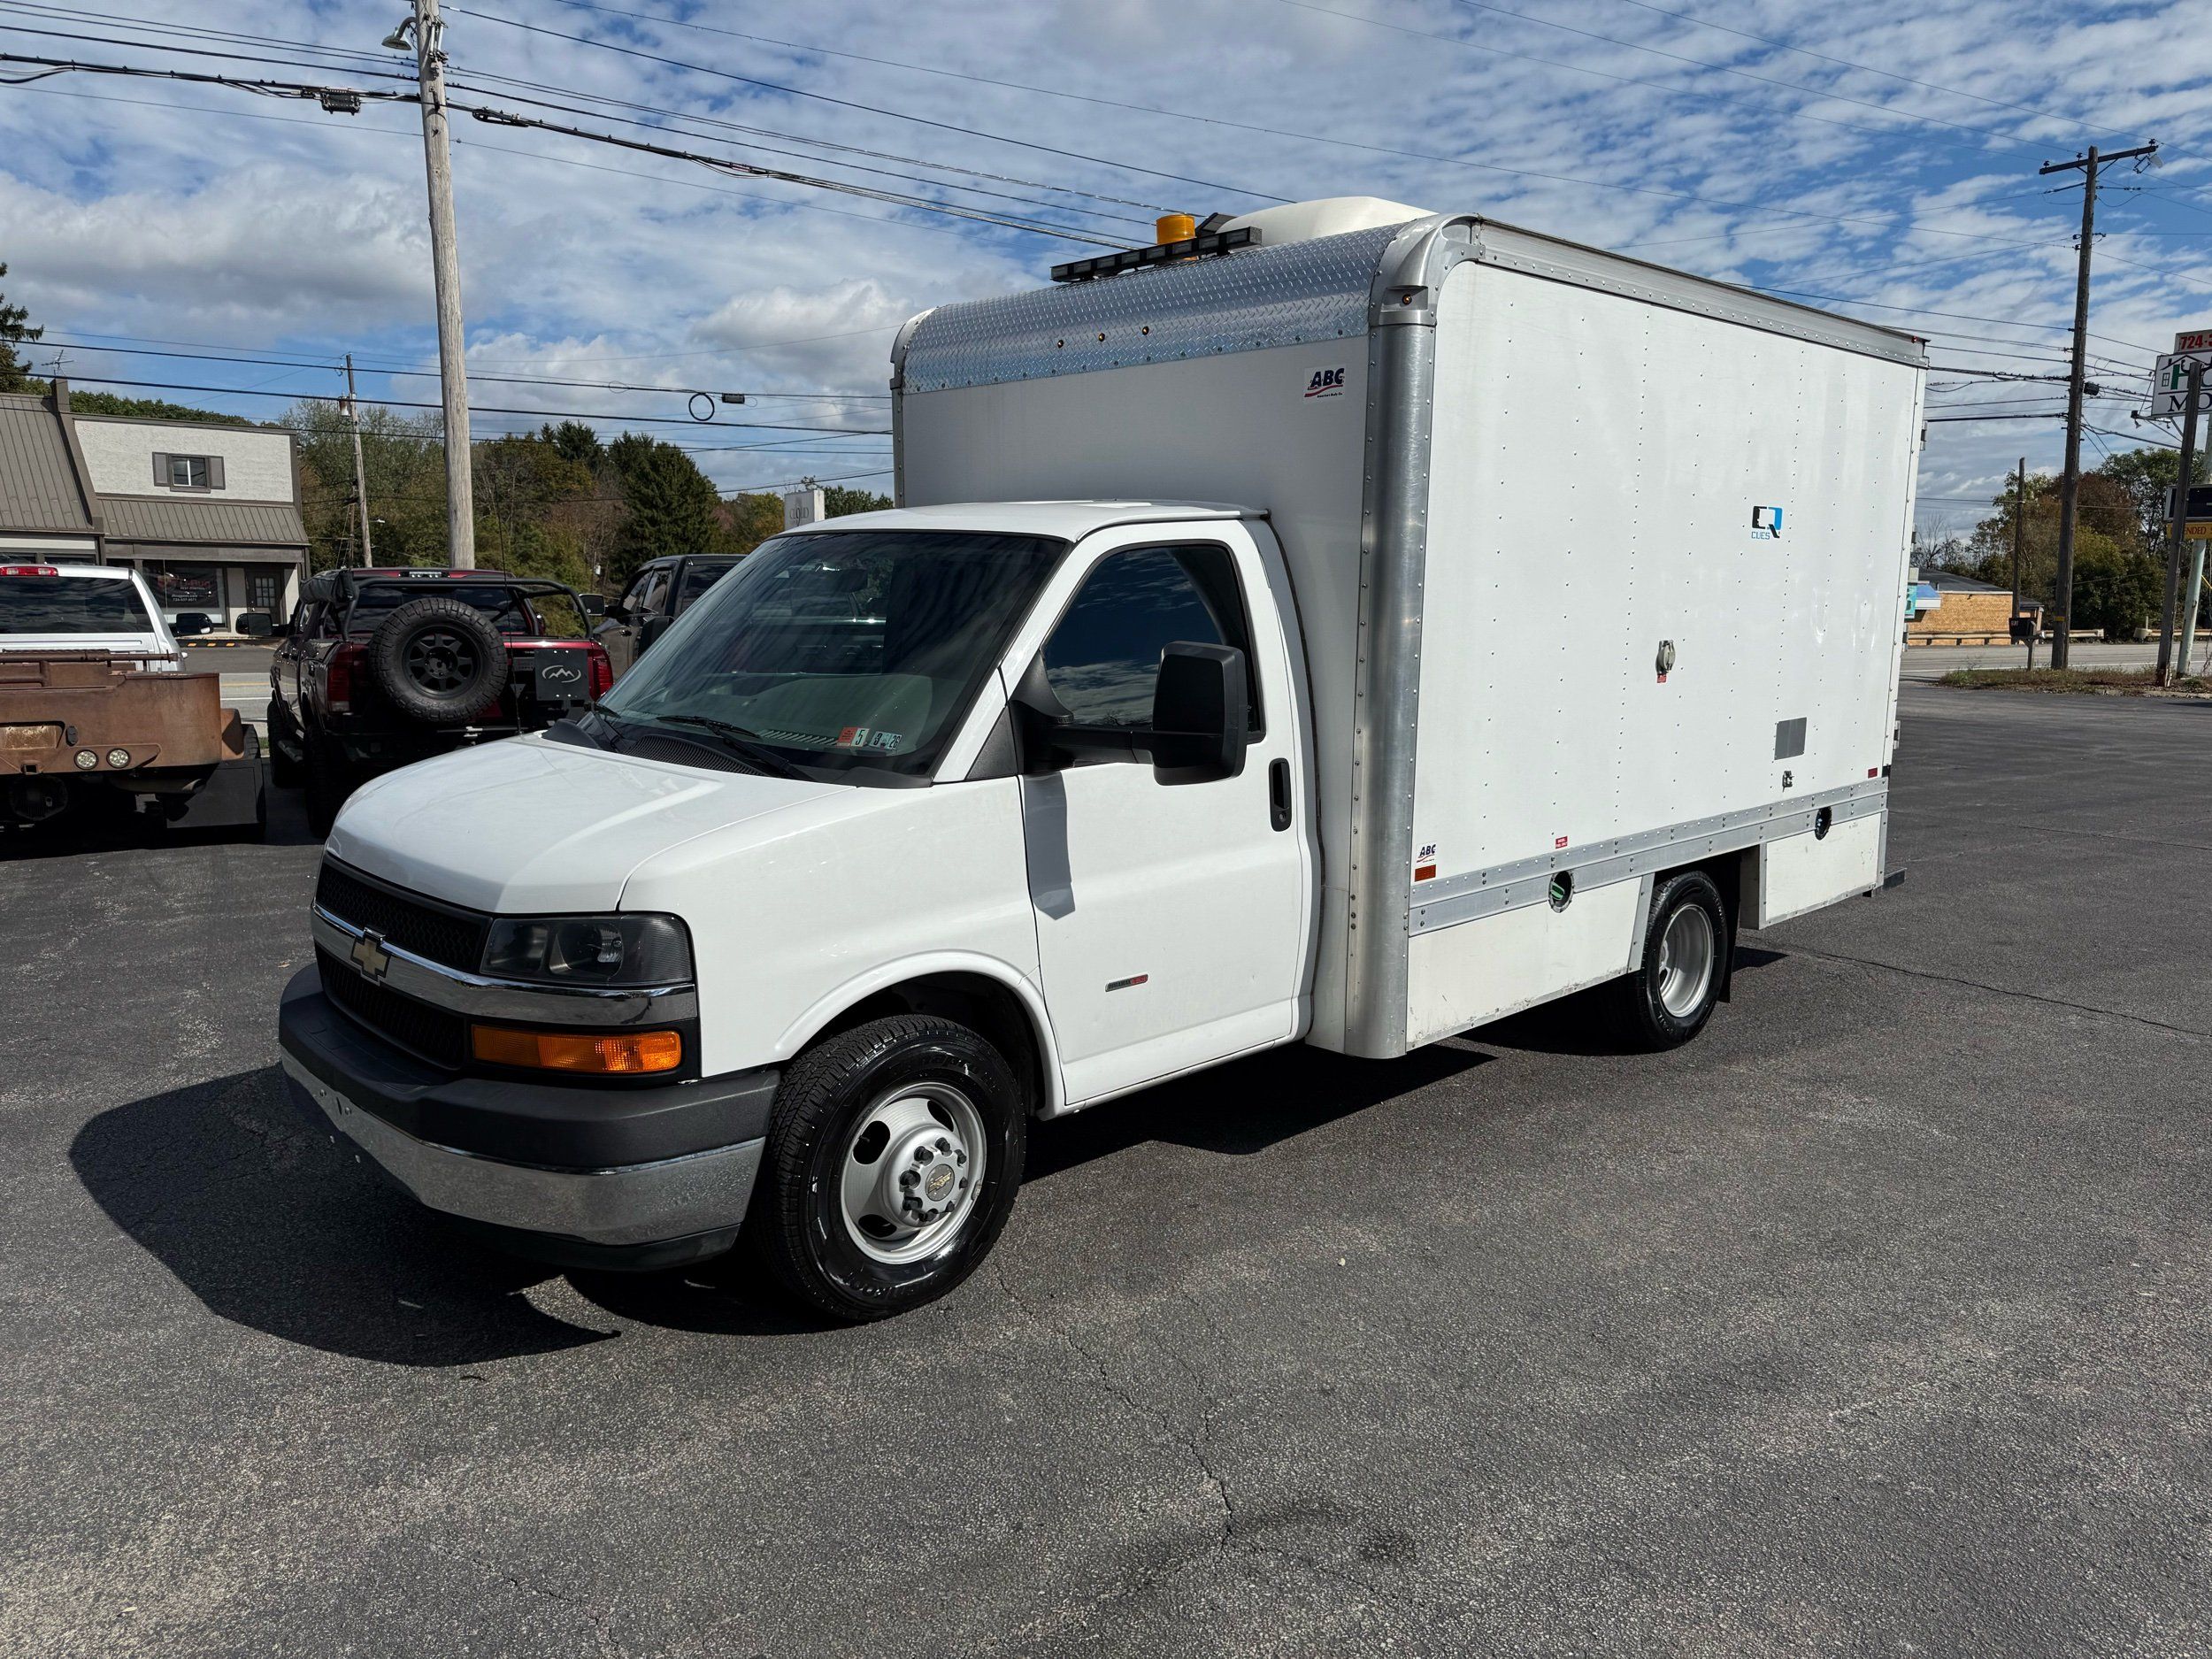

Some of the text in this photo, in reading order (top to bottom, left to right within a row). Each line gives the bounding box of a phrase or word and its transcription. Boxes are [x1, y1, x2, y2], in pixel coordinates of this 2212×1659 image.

[1310, 368, 1345, 388] ABC
[855, 729, 865, 746] 5
[1419, 844, 1436, 856] ABC
